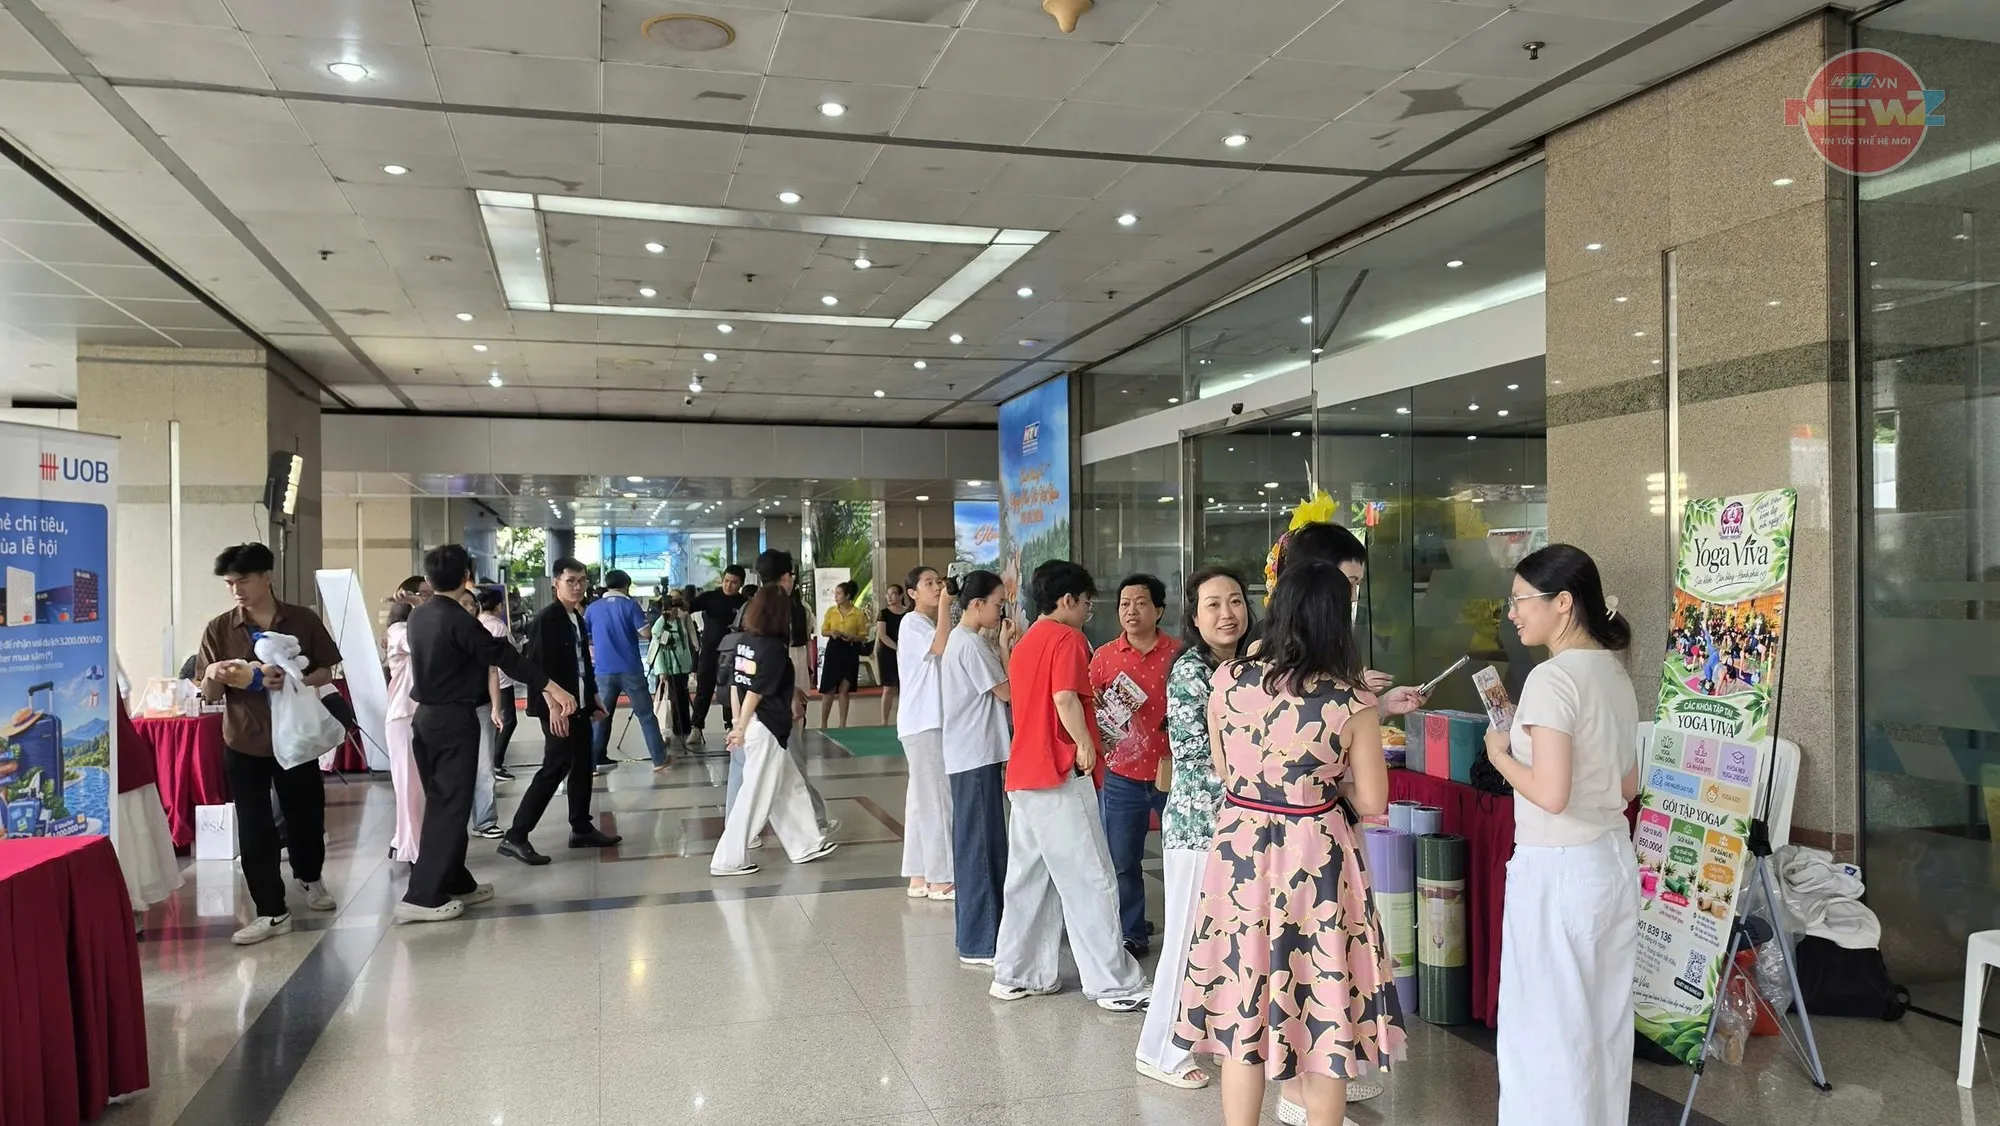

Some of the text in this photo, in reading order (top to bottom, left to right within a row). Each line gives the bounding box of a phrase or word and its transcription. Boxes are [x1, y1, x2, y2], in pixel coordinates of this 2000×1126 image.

[63, 457, 109, 484] UOB
[15, 514, 37, 531] chi
[40, 515, 69, 535] tiêu,
[1722, 526, 1740, 535] VIVA
[22, 535, 35, 555] lễ
[39, 538, 58, 558] hội
[1694, 534, 1769, 573] Yoga Viva
[1683, 700, 1733, 719] CÁC KHÓA TẬP TẠI
[1678, 715, 1734, 738] YOGA VIVA
[1662, 799, 1720, 827] GÓI TẬP YOGA
[1647, 924, 1660, 937] 839
[1661, 930, 1672, 943] 136
